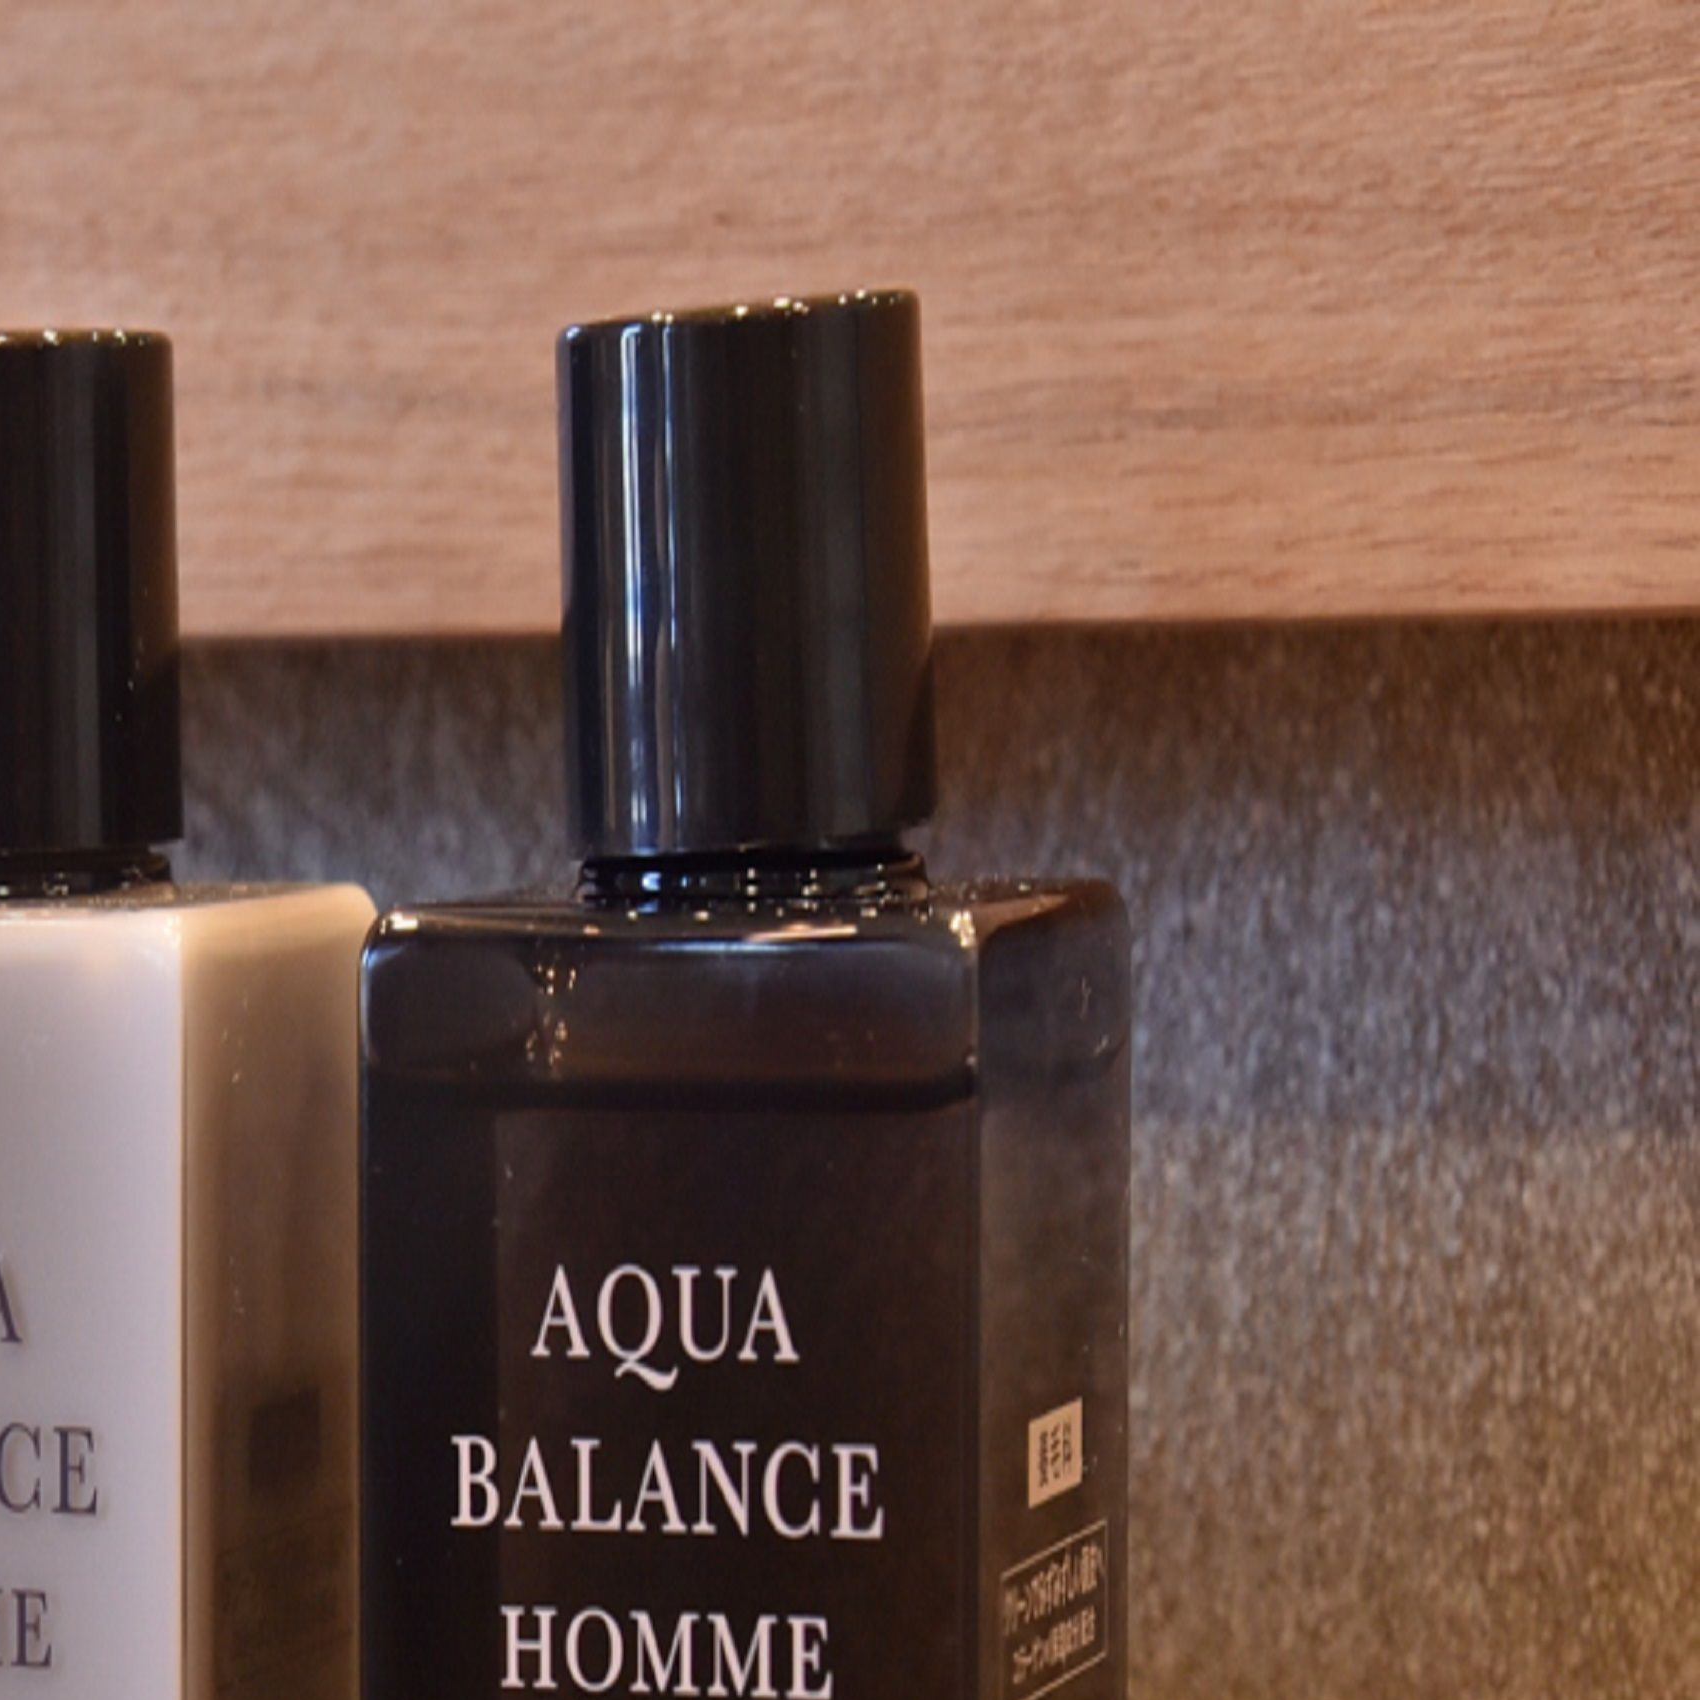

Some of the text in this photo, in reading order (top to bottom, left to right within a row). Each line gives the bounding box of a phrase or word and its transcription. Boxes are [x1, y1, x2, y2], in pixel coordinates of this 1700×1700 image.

[531, 1264, 799, 1391] AQUA
[451, 1435, 885, 1539] BALANCE
[501, 1605, 834, 1700] HOMME
